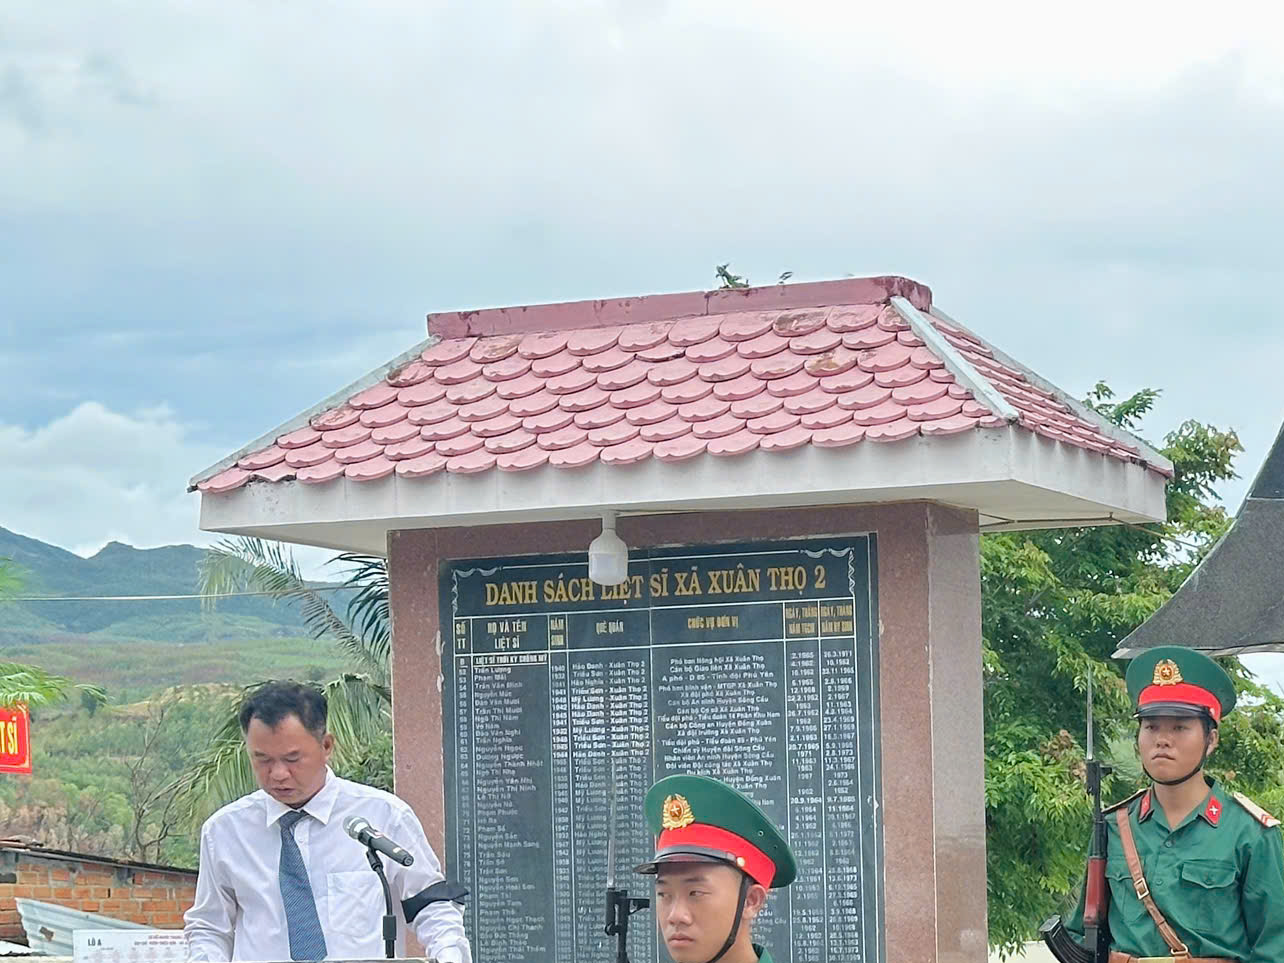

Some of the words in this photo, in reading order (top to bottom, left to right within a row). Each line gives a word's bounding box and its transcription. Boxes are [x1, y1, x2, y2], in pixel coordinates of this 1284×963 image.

[485, 581, 538, 606] DANH
[544, 573, 595, 603] SÁCH
[650, 568, 669, 597] SĨ
[674, 566, 702, 596] XÃ
[708, 563, 760, 595] XUÂN
[767, 566, 807, 595] THỌ
[814, 565, 825, 589] 2
[500, 620, 510, 633] VÀ
[457, 638, 466, 649] TT
